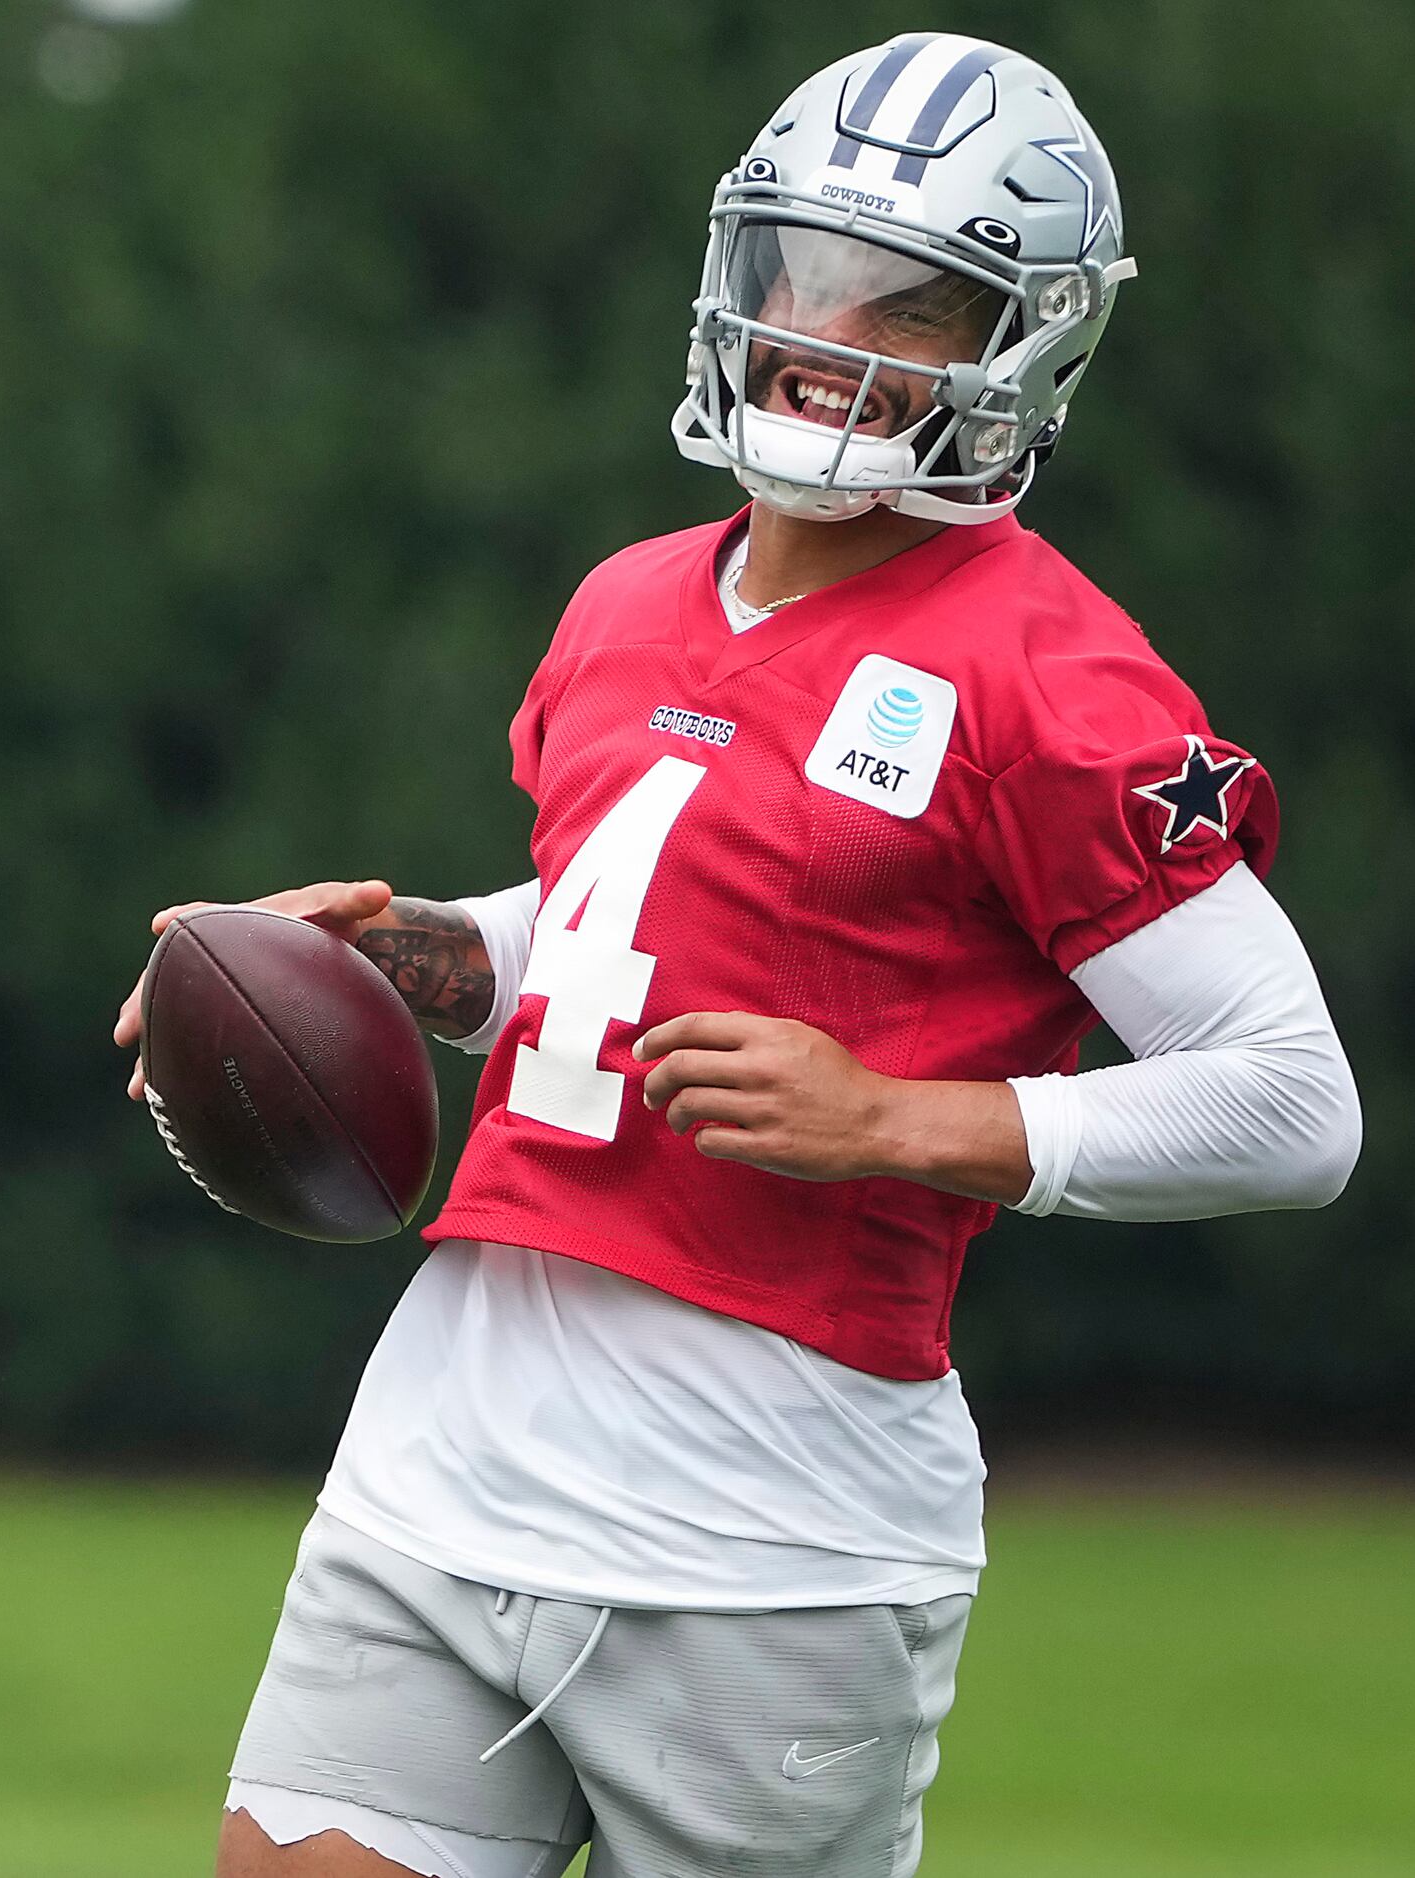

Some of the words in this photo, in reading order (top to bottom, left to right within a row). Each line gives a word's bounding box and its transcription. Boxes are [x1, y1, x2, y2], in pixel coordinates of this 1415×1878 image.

[821, 184, 896, 214] COWBOYS
[648, 705, 736, 746] COWBOYS
[836, 749, 910, 792] AT&T
[506, 754, 708, 1142] 4
[223, 1057, 258, 1119] LEAGUE
